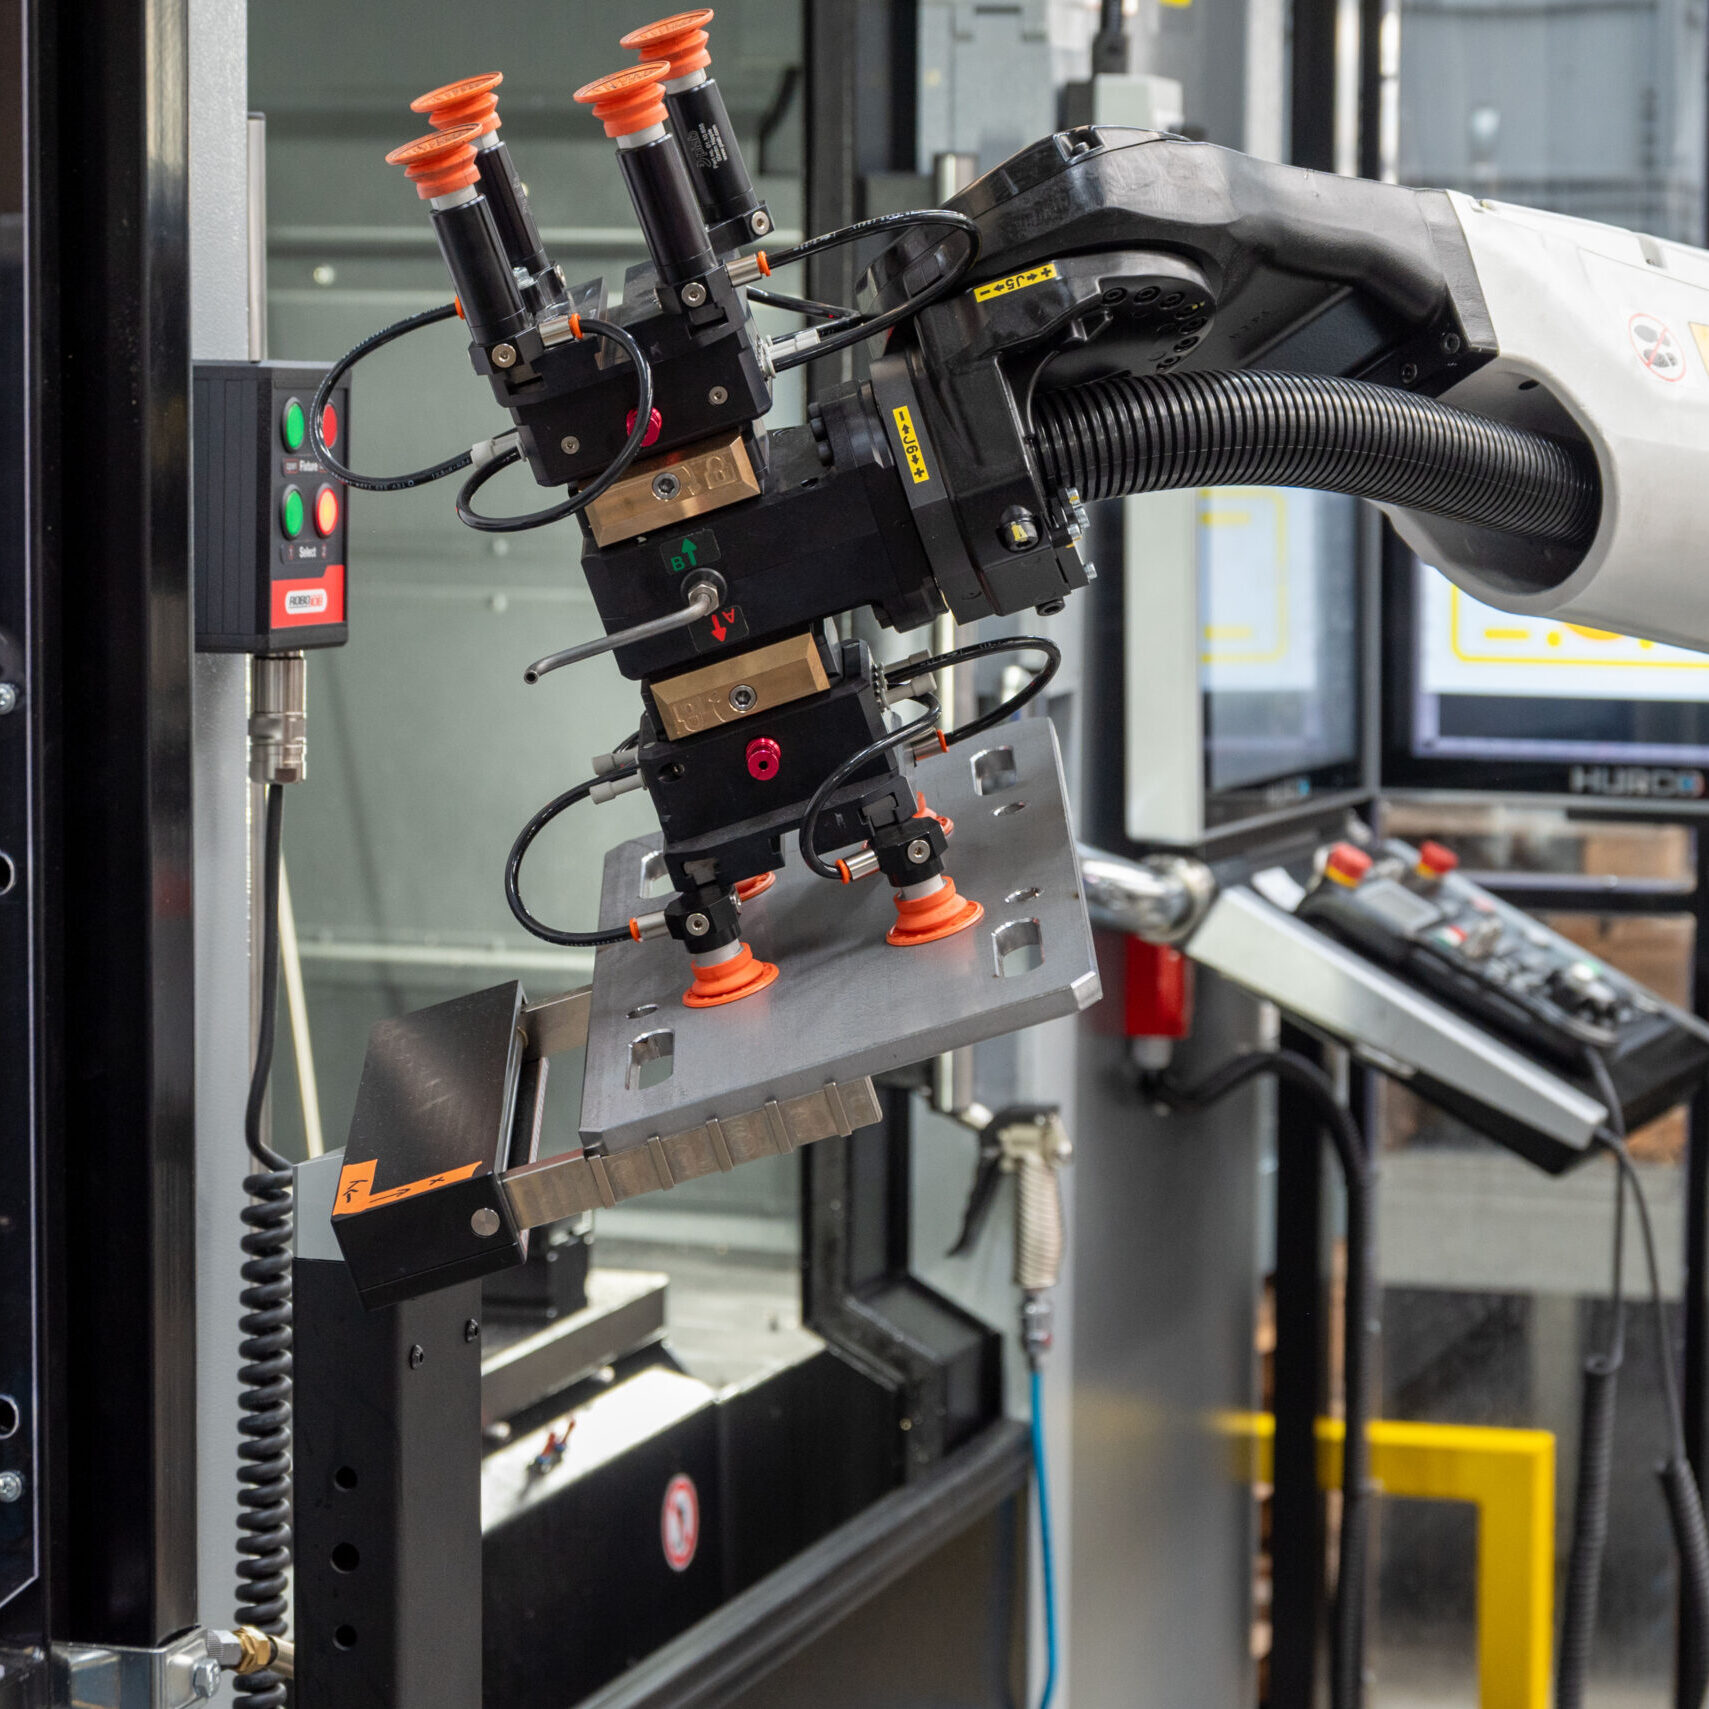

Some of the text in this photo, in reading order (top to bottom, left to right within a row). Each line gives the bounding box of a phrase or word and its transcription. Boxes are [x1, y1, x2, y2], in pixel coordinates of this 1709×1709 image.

[1006, 274, 1025, 292] J5
[903, 436, 919, 454] J6
[299, 546, 317, 558] Select
[671, 556, 686, 572] B
[722, 608, 736, 624] A
[1570, 765, 1706, 799] HURCO
